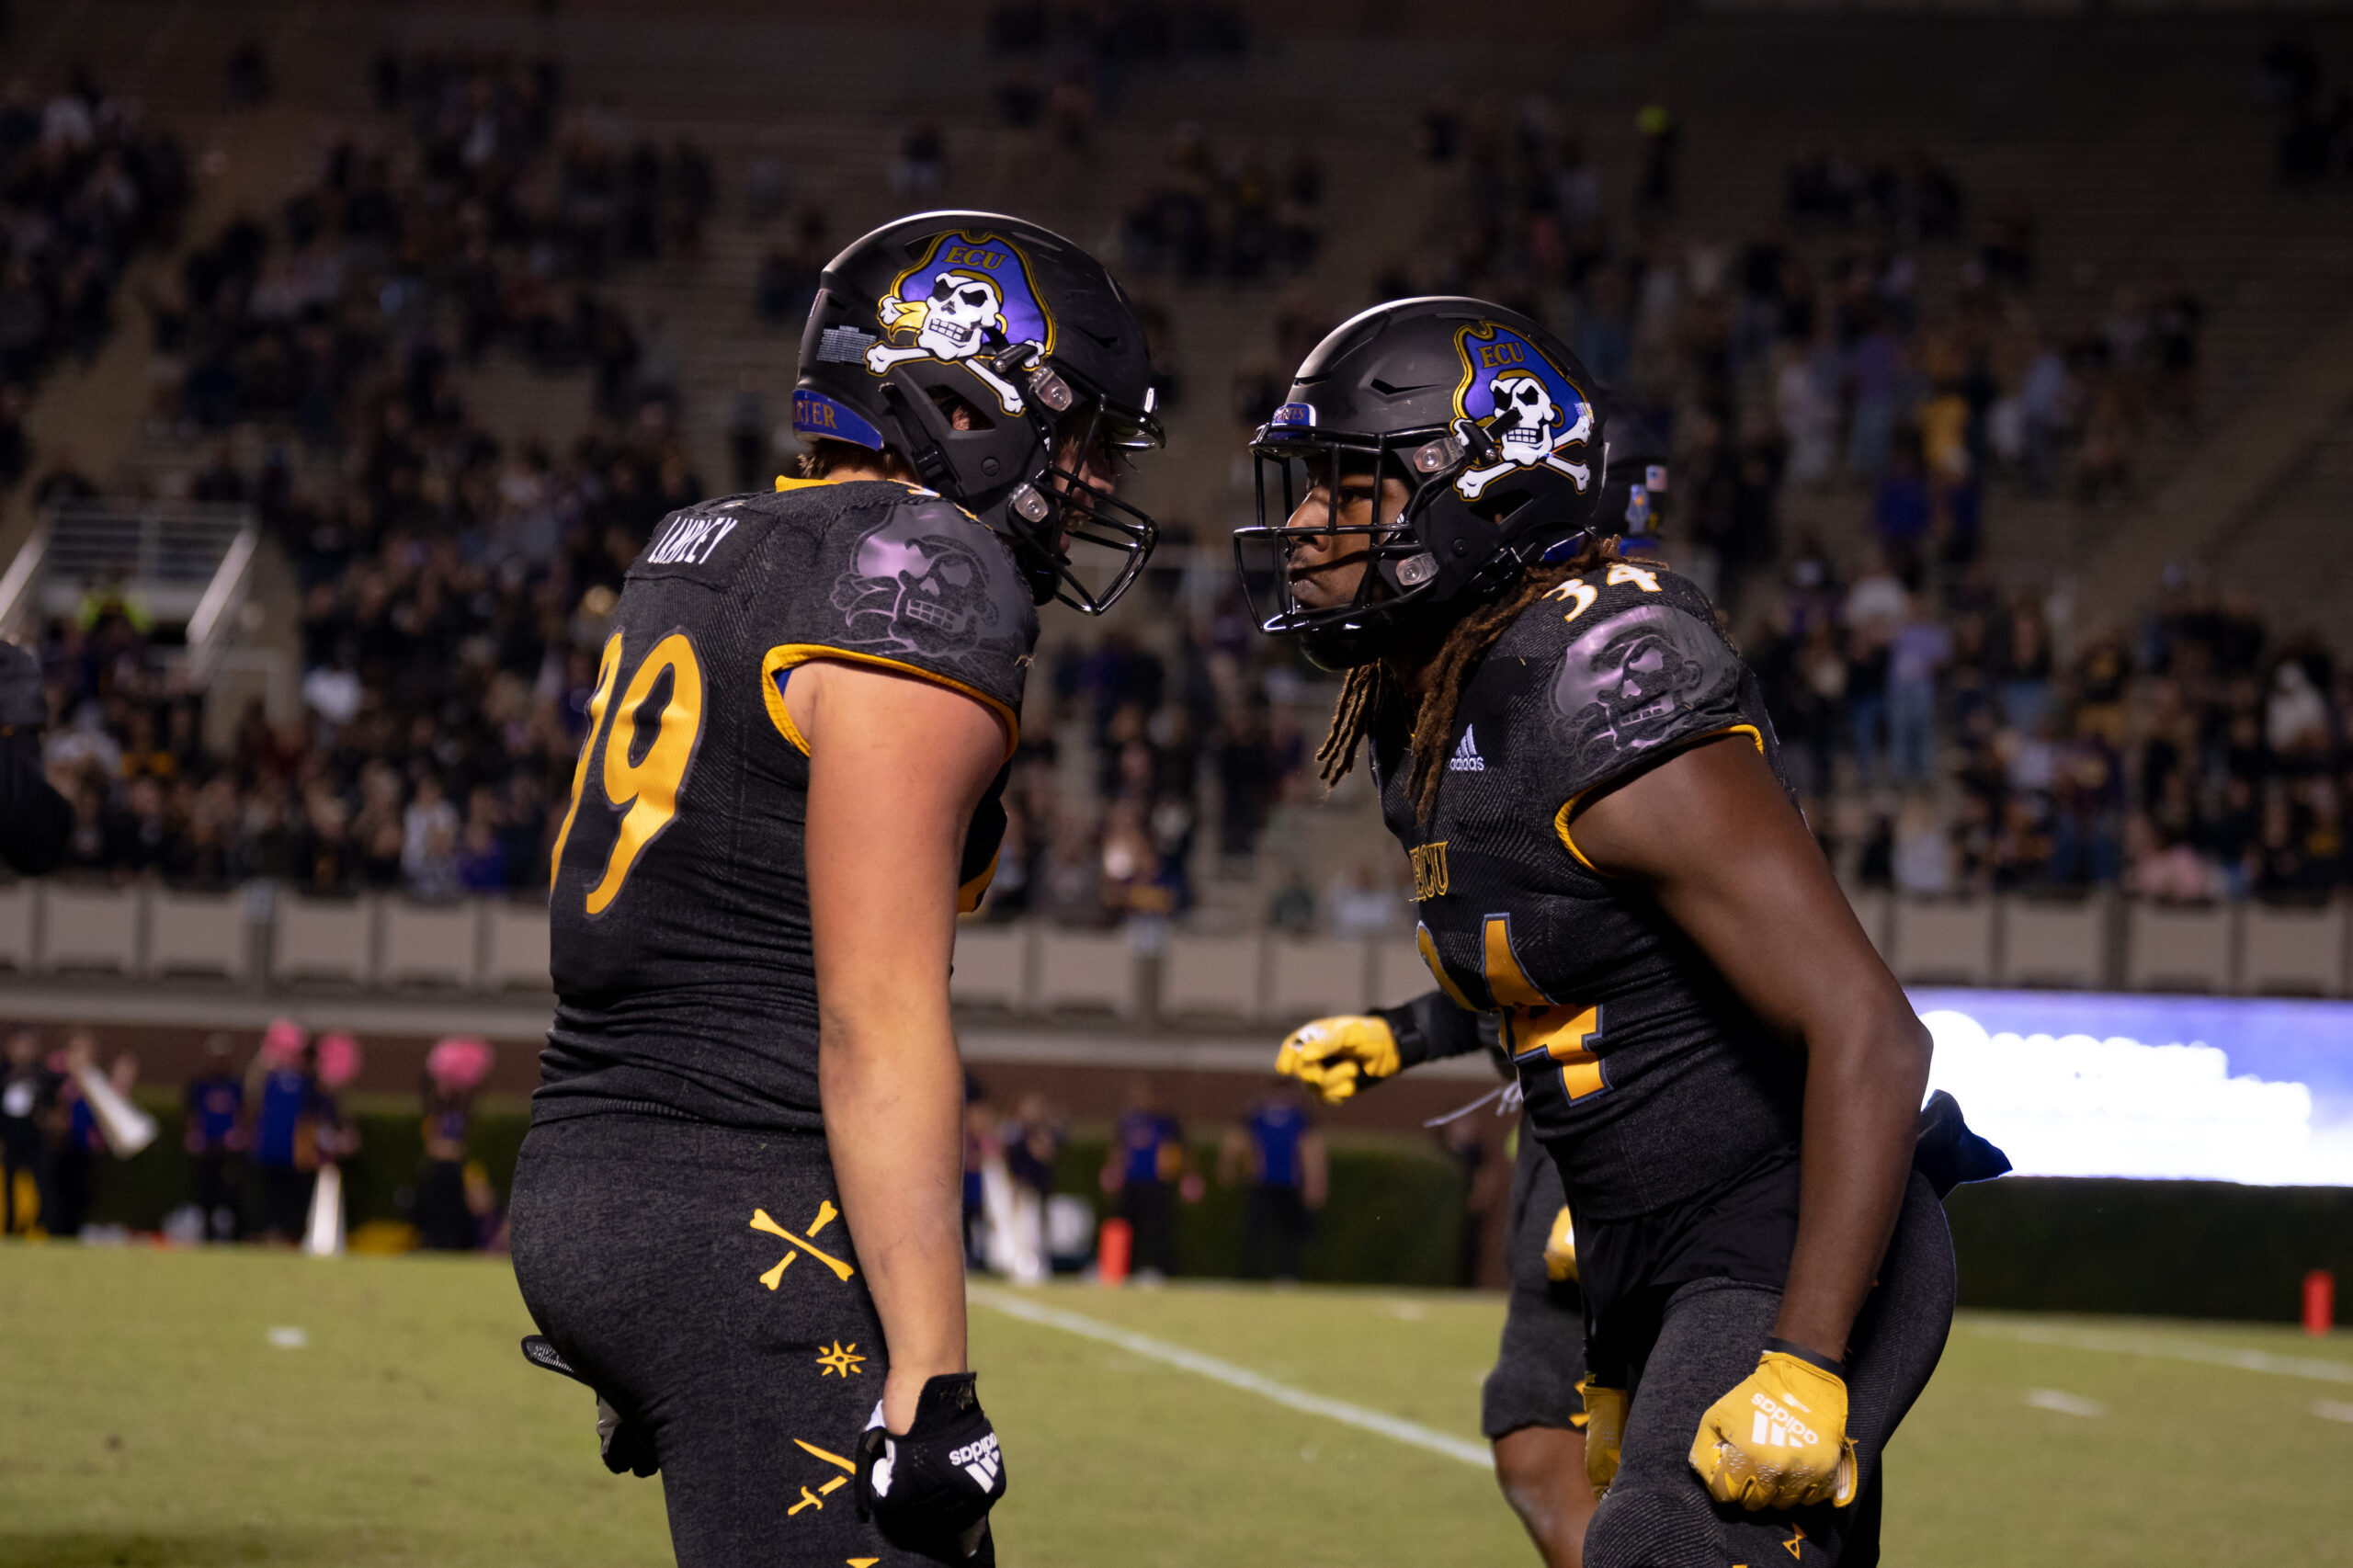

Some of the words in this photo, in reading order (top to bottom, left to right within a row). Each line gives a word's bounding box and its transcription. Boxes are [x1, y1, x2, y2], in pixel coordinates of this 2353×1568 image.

[943, 245, 1007, 269] ECU
[1478, 342, 1524, 369] ECU
[1542, 563, 1663, 622] 34
[1449, 755, 1484, 771] adidas
[1408, 840, 1449, 903] ECU
[1750, 1392, 1819, 1445] adidas
